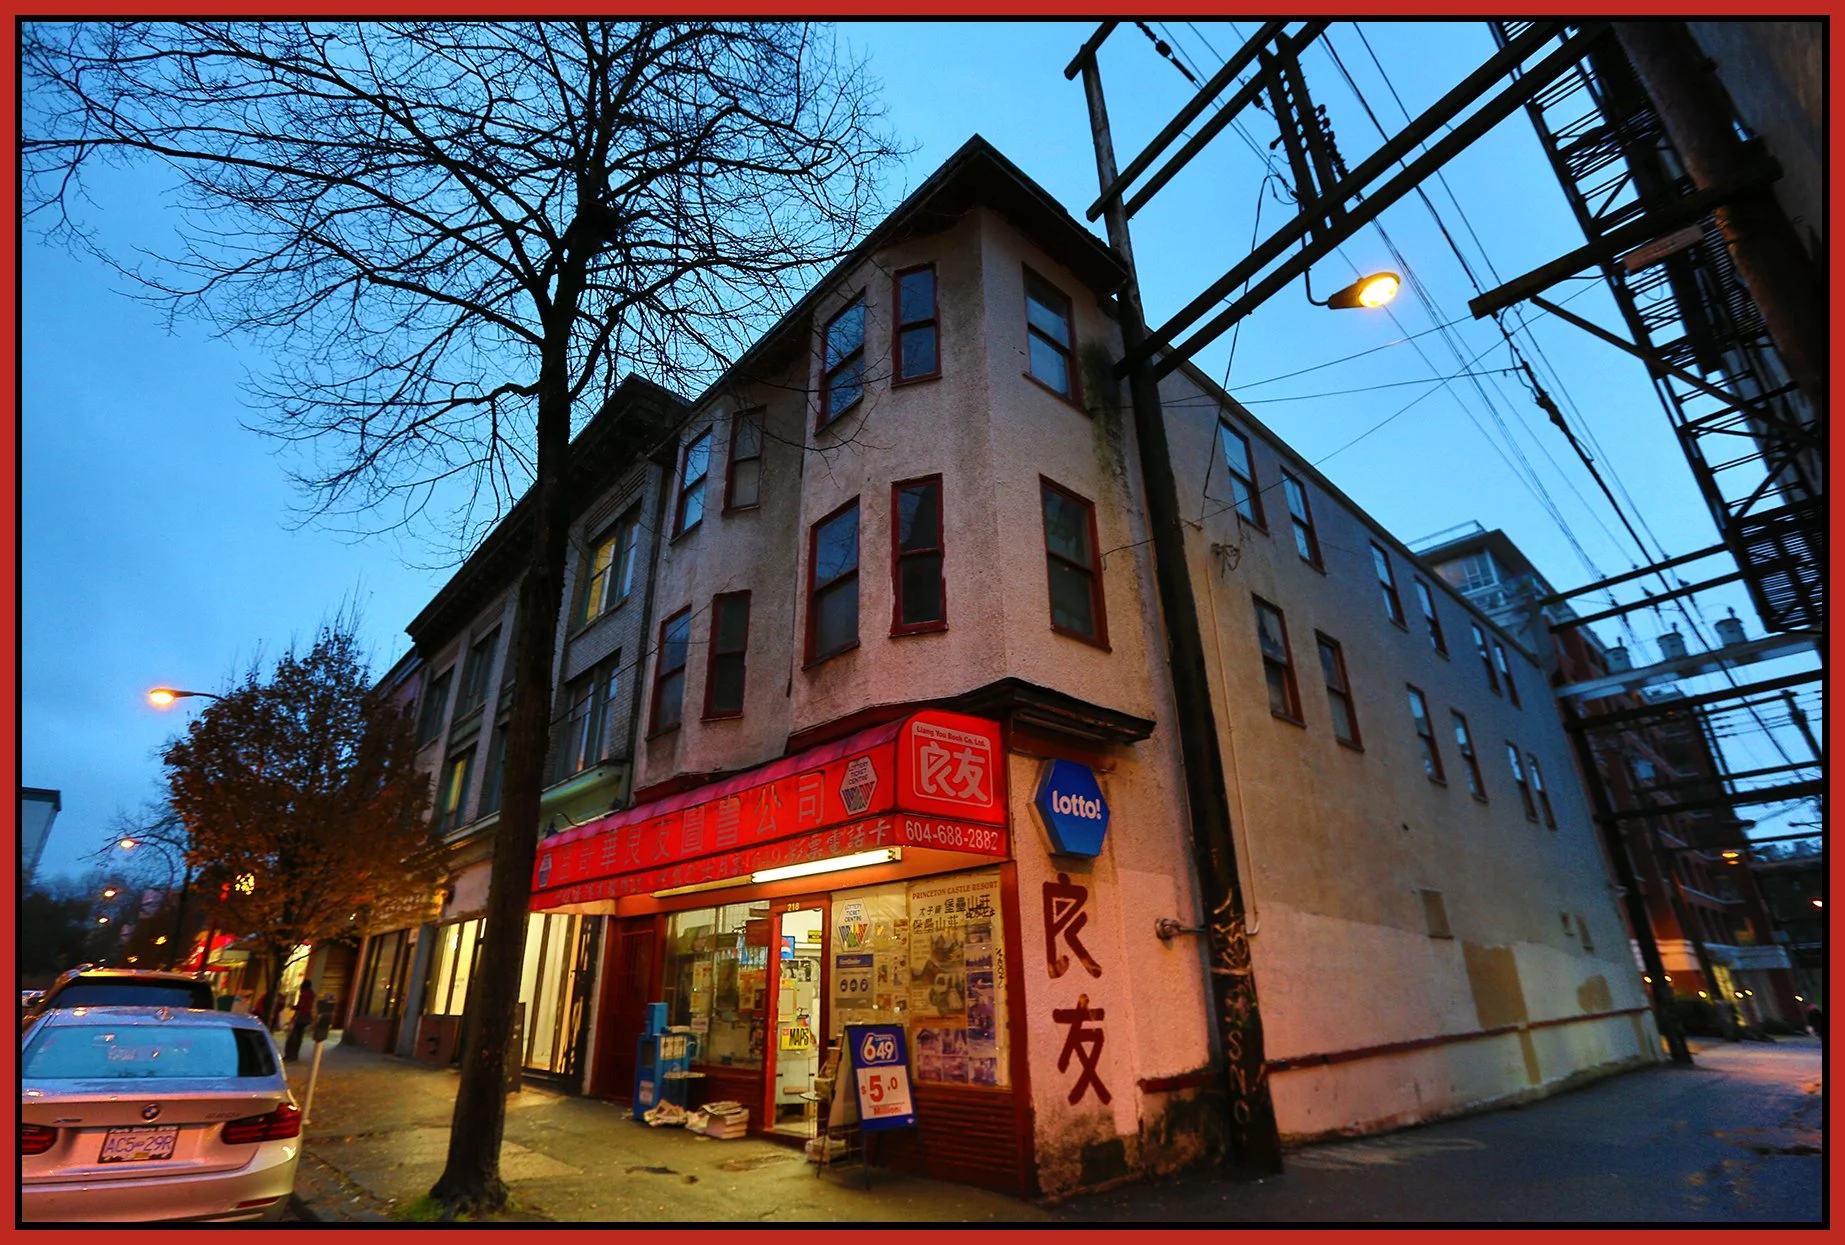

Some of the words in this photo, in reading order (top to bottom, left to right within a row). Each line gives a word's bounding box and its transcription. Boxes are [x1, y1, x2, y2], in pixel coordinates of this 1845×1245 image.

[917, 726, 934, 737] Liang
[935, 730, 946, 739] You
[947, 733, 963, 742] Book
[920, 741, 988, 801] 良友
[1052, 790, 1102, 820] lotto!
[905, 820, 998, 851] 604-688-2882
[912, 888, 946, 900] PRINCETON
[947, 884, 970, 895] CASTLE
[972, 880, 998, 891] RESORT
[787, 902, 800, 912] 218
[1043, 872, 1112, 1105] 良友
[789, 1028, 809, 1048] MAPS
